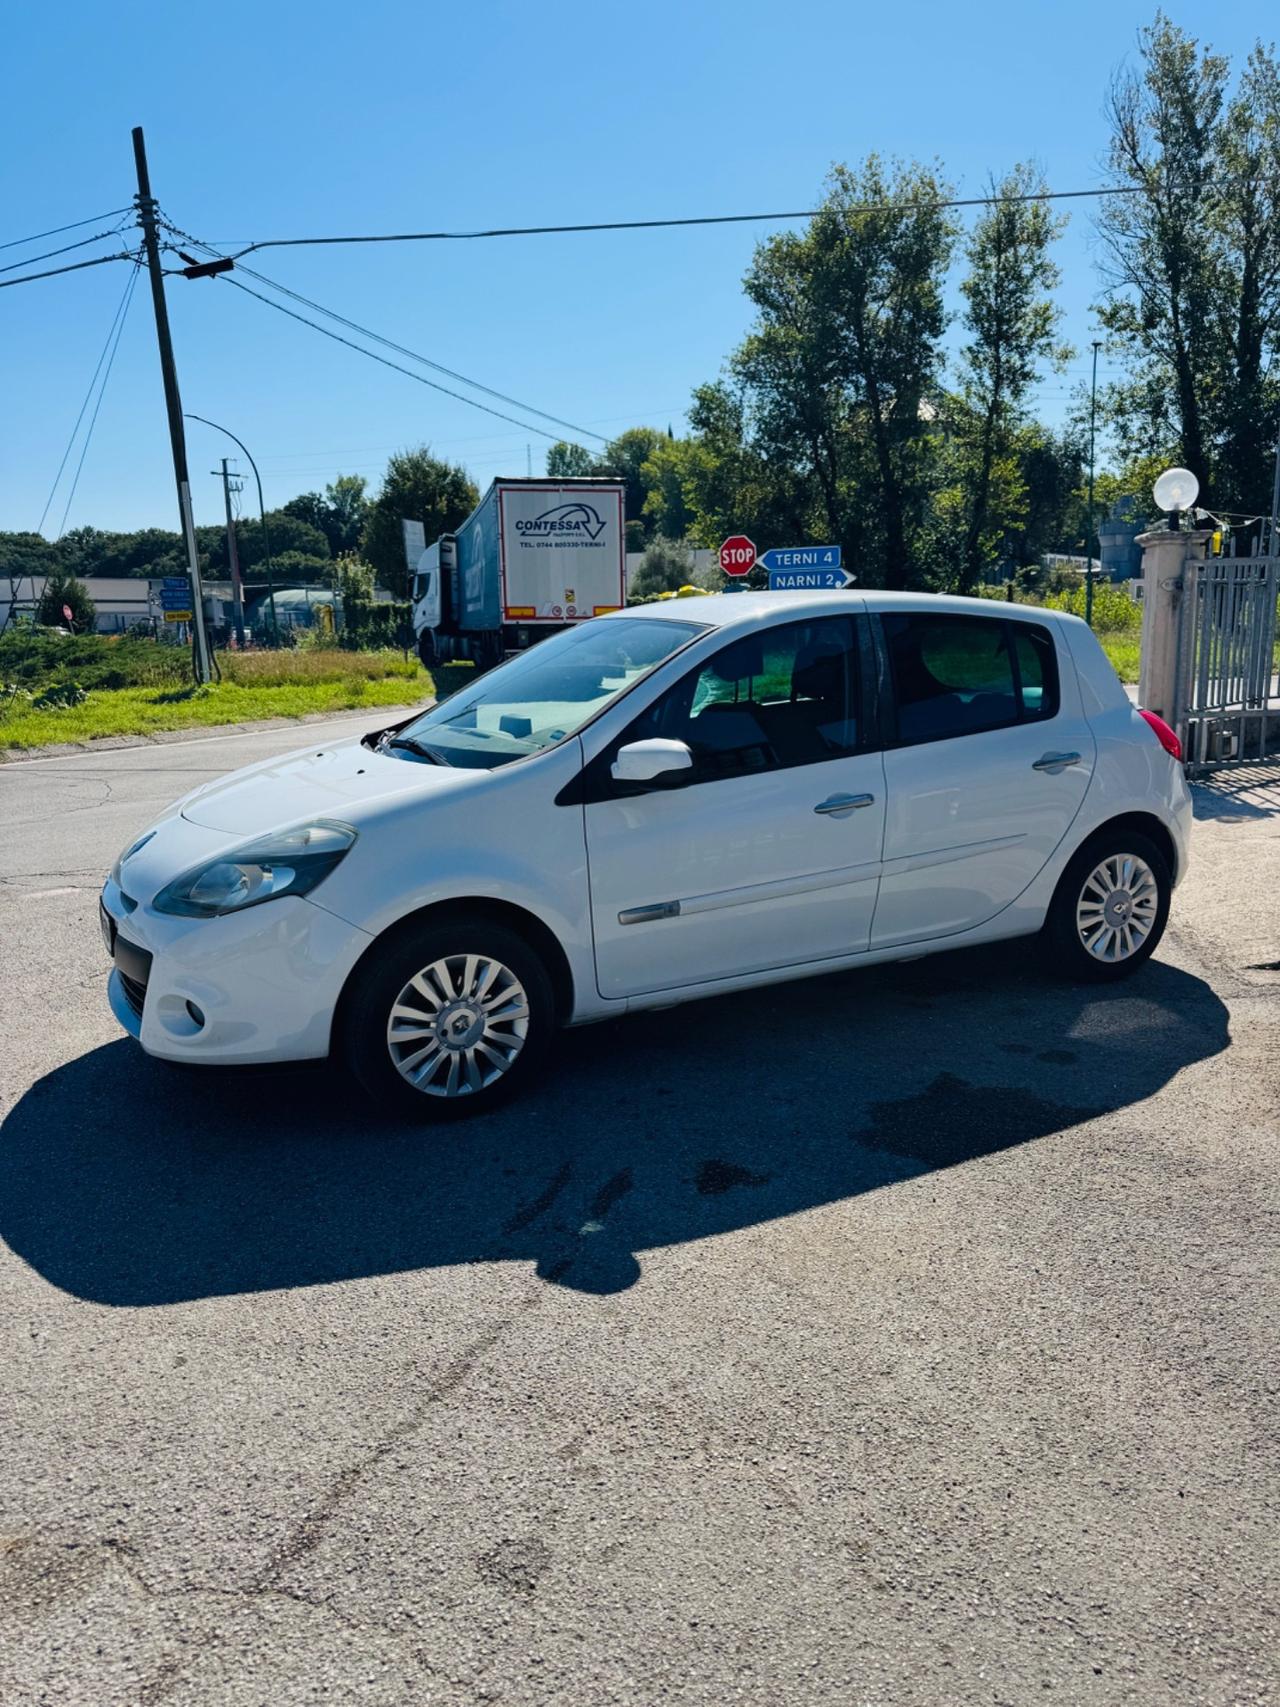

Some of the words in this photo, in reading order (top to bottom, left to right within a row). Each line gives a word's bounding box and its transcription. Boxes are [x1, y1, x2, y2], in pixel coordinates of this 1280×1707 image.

[515, 520, 581, 531] CONTESSA
[722, 548, 754, 564] STOP
[775, 552, 818, 566] TERNI
[823, 551, 833, 563] 4
[776, 574, 821, 588] NARNI
[825, 574, 835, 586] 2
